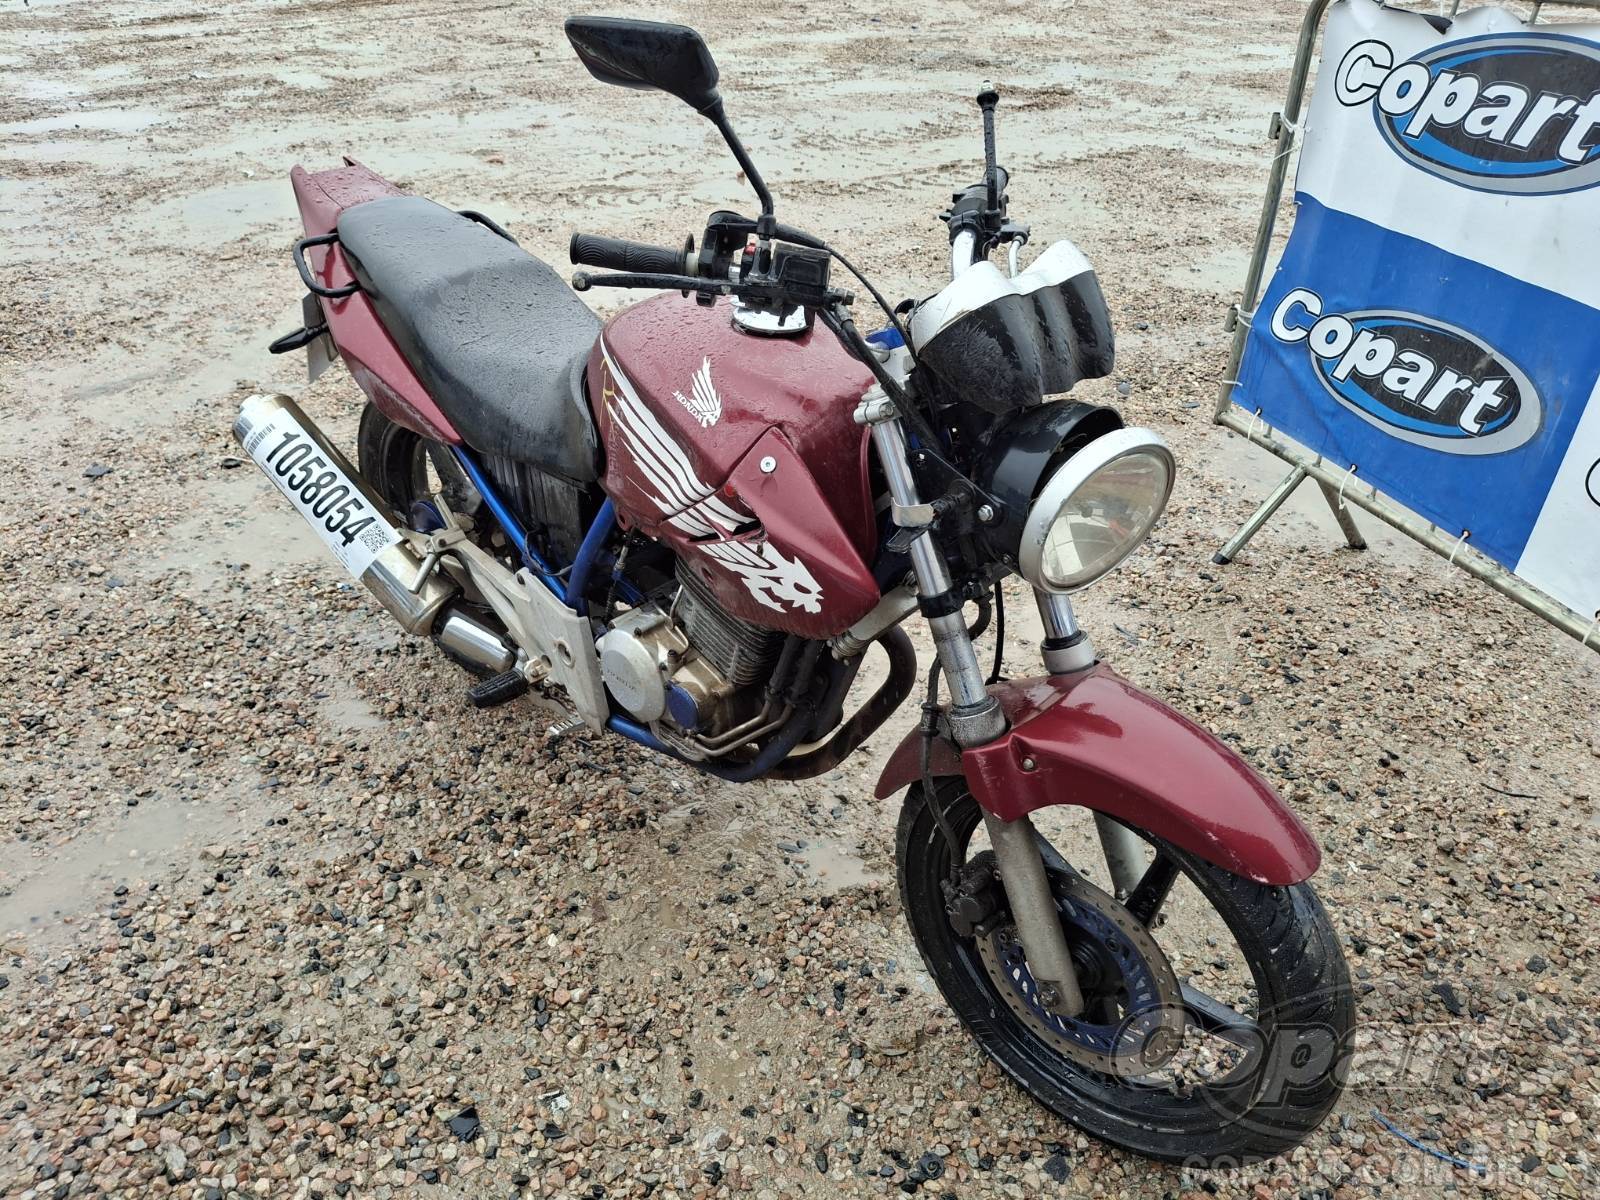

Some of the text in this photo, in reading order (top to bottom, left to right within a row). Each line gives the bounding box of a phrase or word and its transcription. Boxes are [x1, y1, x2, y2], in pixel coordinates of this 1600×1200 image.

[1335, 39, 1600, 165] Copart
[671, 390, 708, 429] HONDA
[1270, 287, 1513, 437] Copart
[266, 431, 376, 547] 1058054
